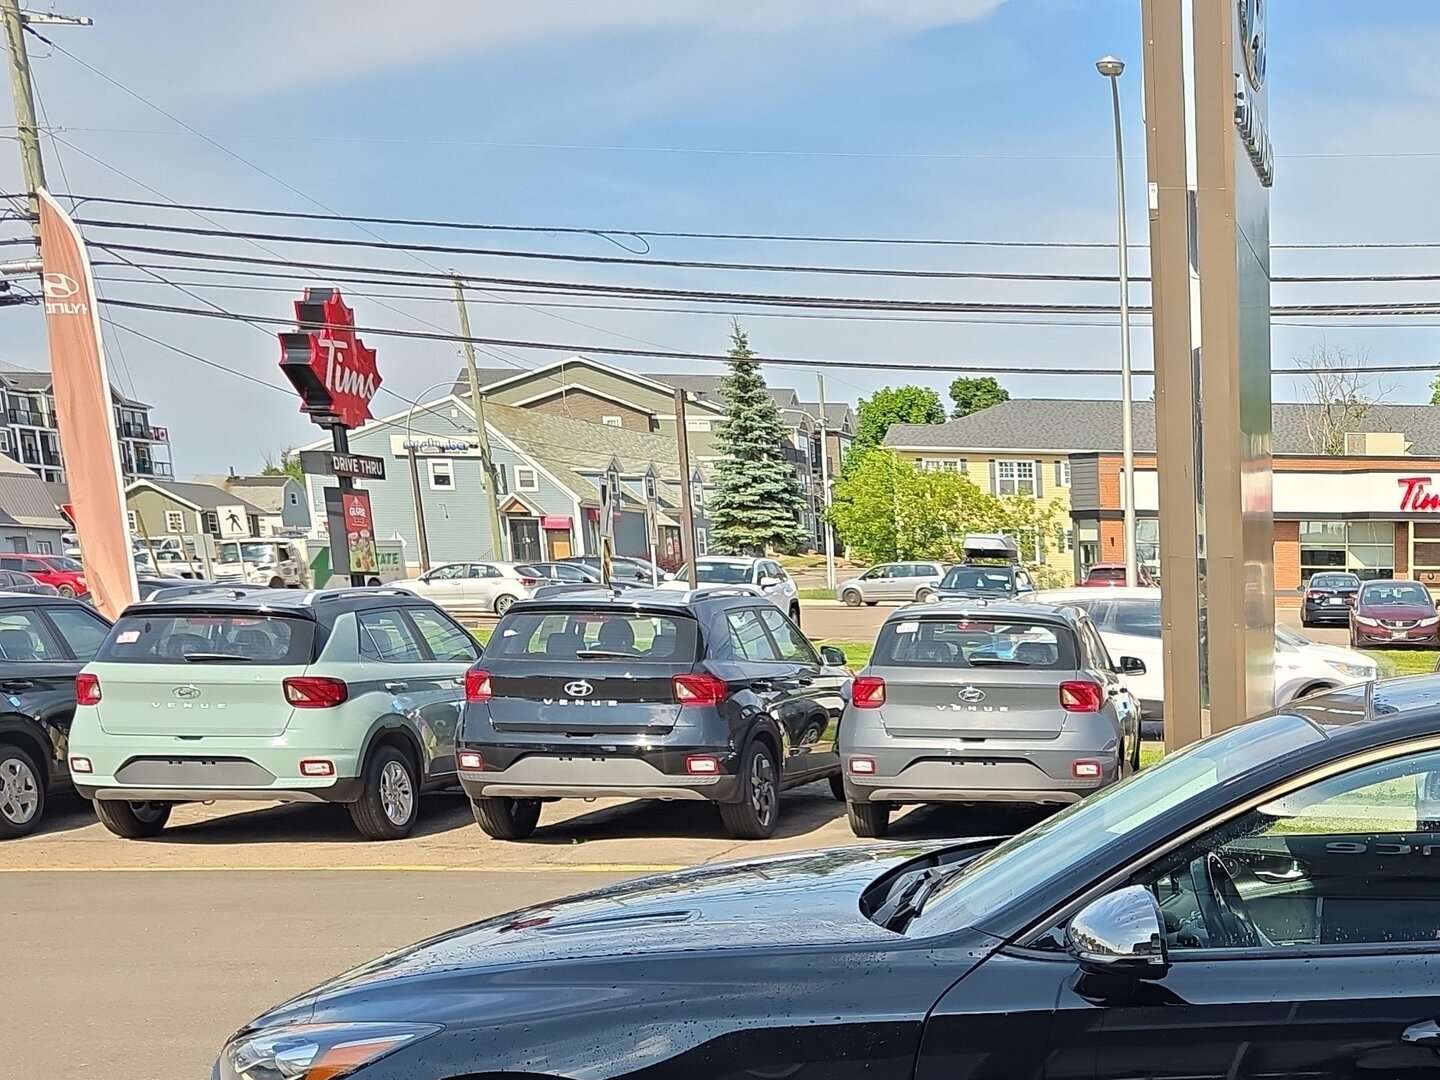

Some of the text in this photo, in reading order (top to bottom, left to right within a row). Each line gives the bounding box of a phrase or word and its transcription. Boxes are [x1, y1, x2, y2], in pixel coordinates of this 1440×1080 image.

[319, 339, 375, 398] Tims
[332, 455, 383, 476] DRIVE THRU
[543, 698, 618, 707] VENUE
[936, 704, 1009, 713] VENUE
